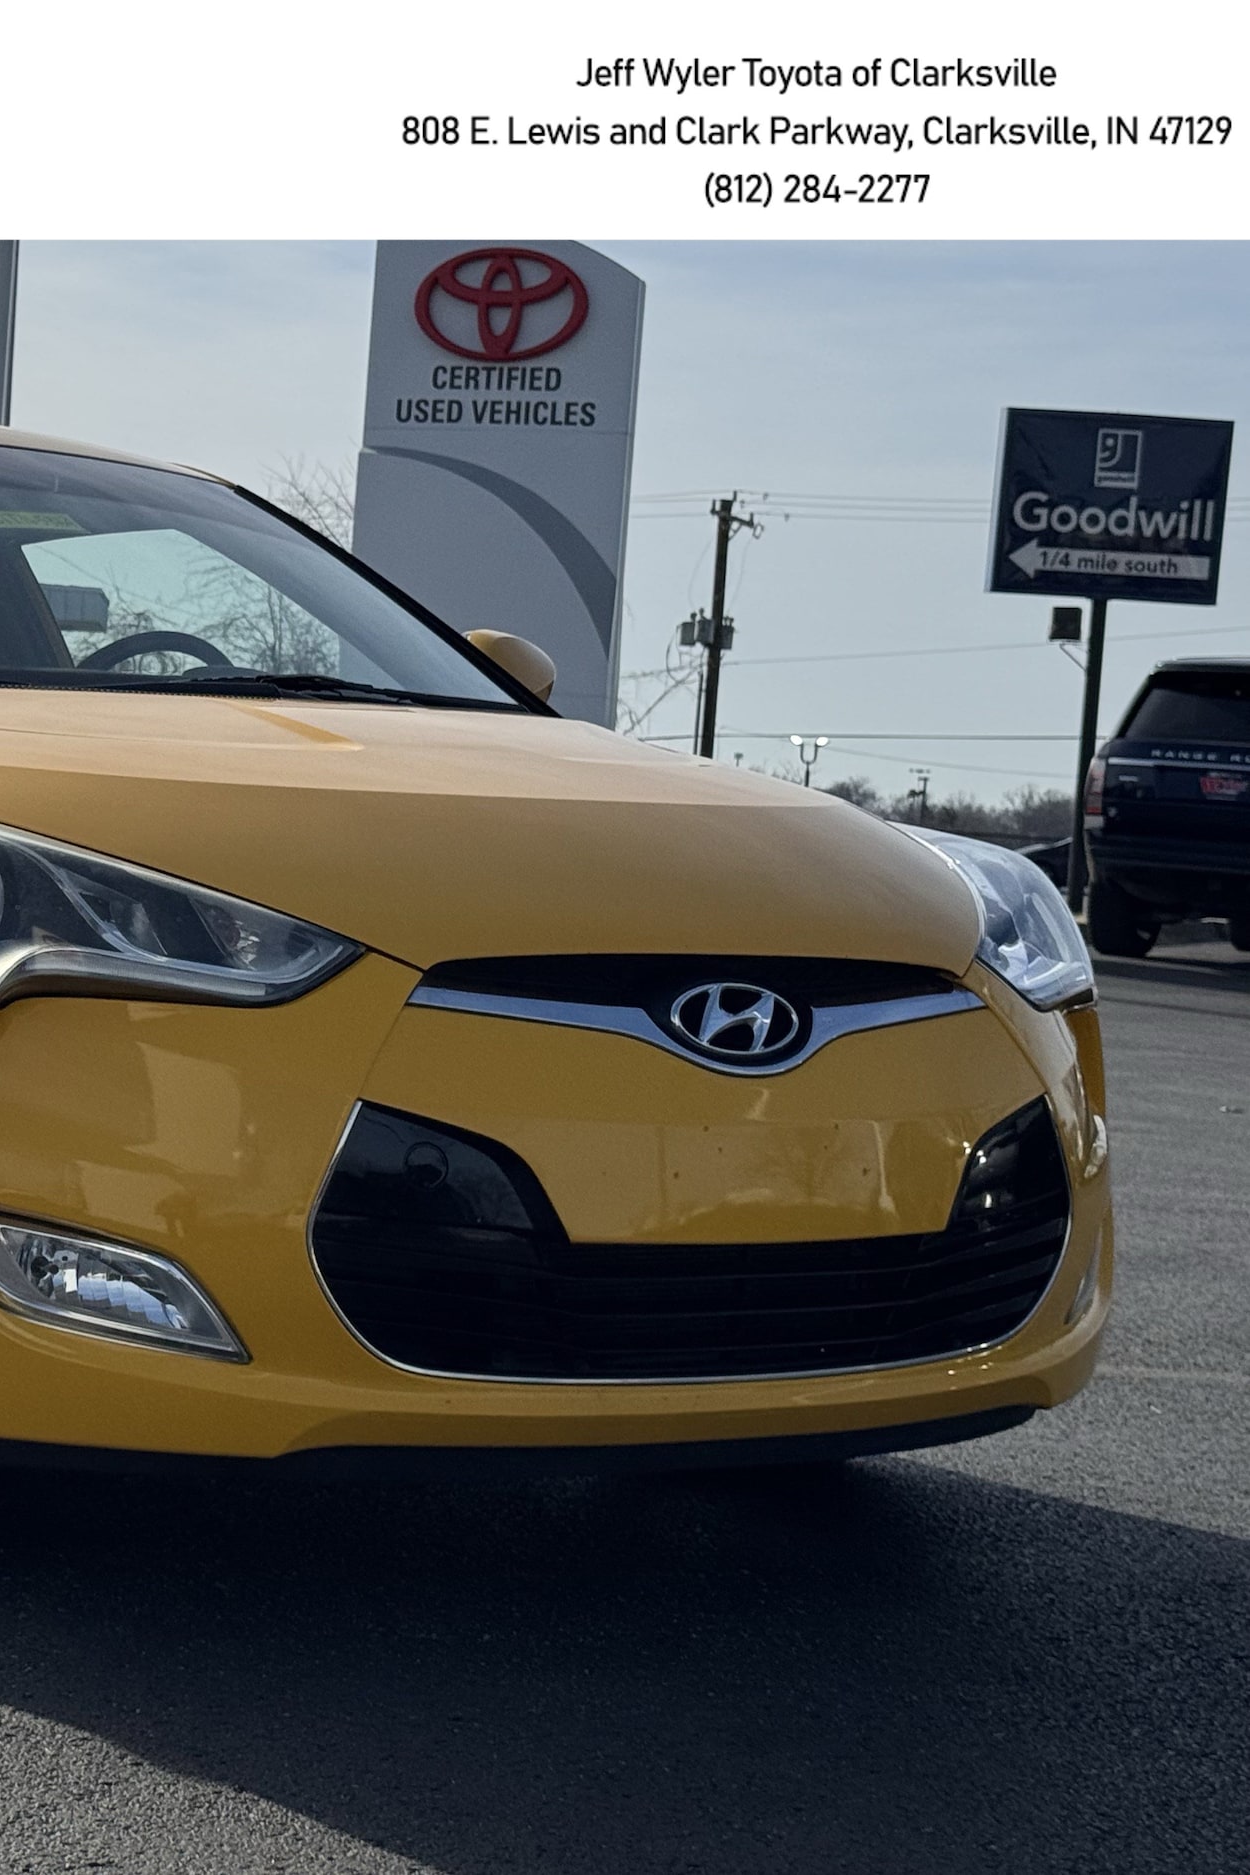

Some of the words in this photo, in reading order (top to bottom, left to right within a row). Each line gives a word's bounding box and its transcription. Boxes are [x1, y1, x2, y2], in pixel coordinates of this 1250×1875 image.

[432, 365, 562, 392] CERTIFIED
[396, 399, 463, 424] USED
[472, 400, 596, 427] VEHICLES
[1013, 490, 1215, 541] Goodwill
[1040, 550, 1072, 570] 1/4
[1077, 553, 1118, 572] mile
[1125, 556, 1178, 575] south
